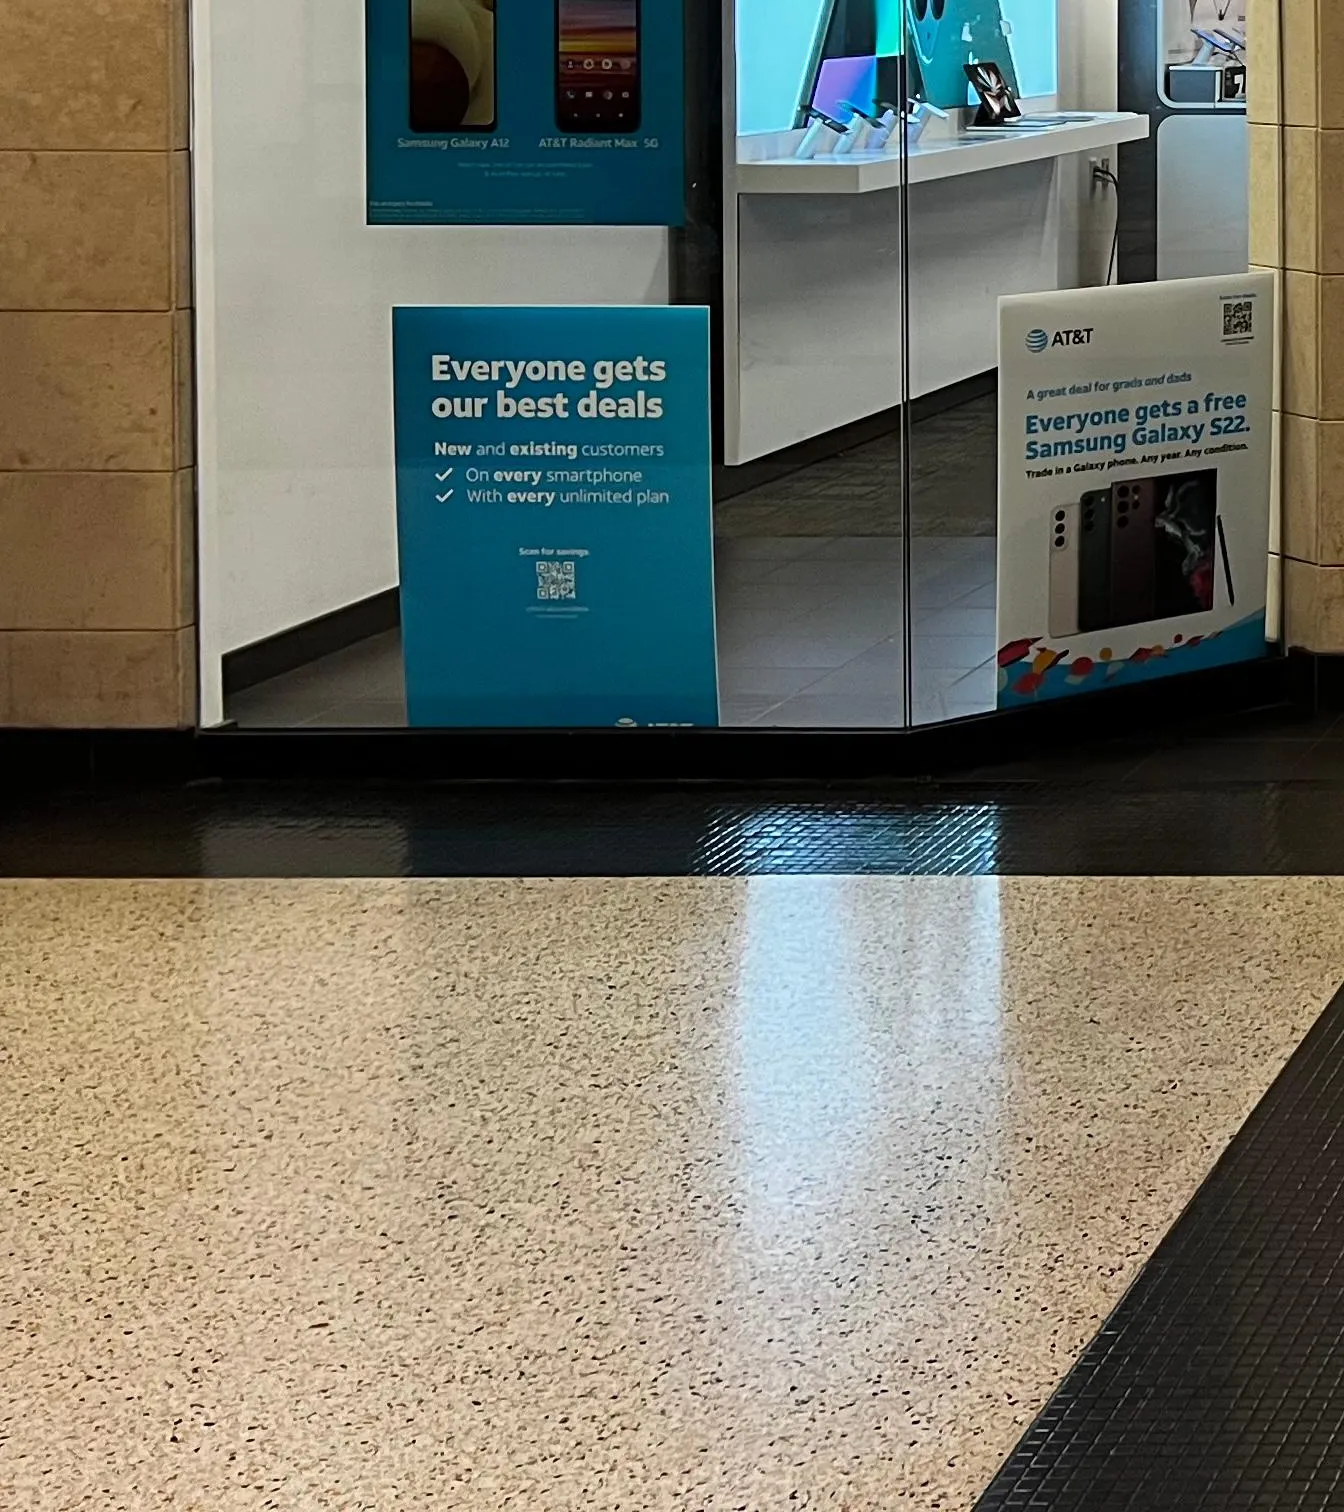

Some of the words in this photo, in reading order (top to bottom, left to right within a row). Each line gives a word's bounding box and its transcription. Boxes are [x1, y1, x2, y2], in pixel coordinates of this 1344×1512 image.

[398, 136, 448, 151] Samsung
[450, 136, 488, 151] Galaxy
[490, 136, 510, 148] A12
[538, 136, 567, 148] AT&T
[569, 136, 612, 148] Radiant
[614, 136, 638, 148] Max
[1051, 328, 1094, 347] AT&T
[431, 354, 586, 388] Everyone
[593, 355, 666, 388] gets
[1037, 387, 1066, 402] great
[1068, 382, 1092, 395] deal
[1094, 380, 1110, 392] for
[1144, 375, 1164, 387] and
[431, 395, 488, 419] our
[496, 391, 569, 419] best
[577, 390, 663, 419] deals
[1025, 407, 1130, 435] Everyone
[1134, 399, 1182, 426] gets
[1187, 399, 1199, 414] a
[1204, 392, 1247, 412] free
[1025, 431, 1126, 461] Samsung
[1132, 421, 1206, 446] Galaxy
[1209, 414, 1251, 436] S22.
[434, 442, 472, 457] New
[476, 442, 505, 457] and
[510, 441, 578, 460] existing
[582, 443, 664, 457] customers
[1025, 468, 1053, 479] Trade
[1055, 467, 1064, 476] in
[1073, 462, 1106, 474] Galaxy
[1140, 454, 1159, 466] Any
[1184, 449, 1202, 460] Any
[466, 468, 490, 482] On
[493, 470, 541, 486] every
[546, 468, 642, 486] smartphone
[466, 489, 503, 504] With
[507, 491, 555, 507] every
[560, 489, 632, 504] unlimited
[637, 489, 669, 507] plan
